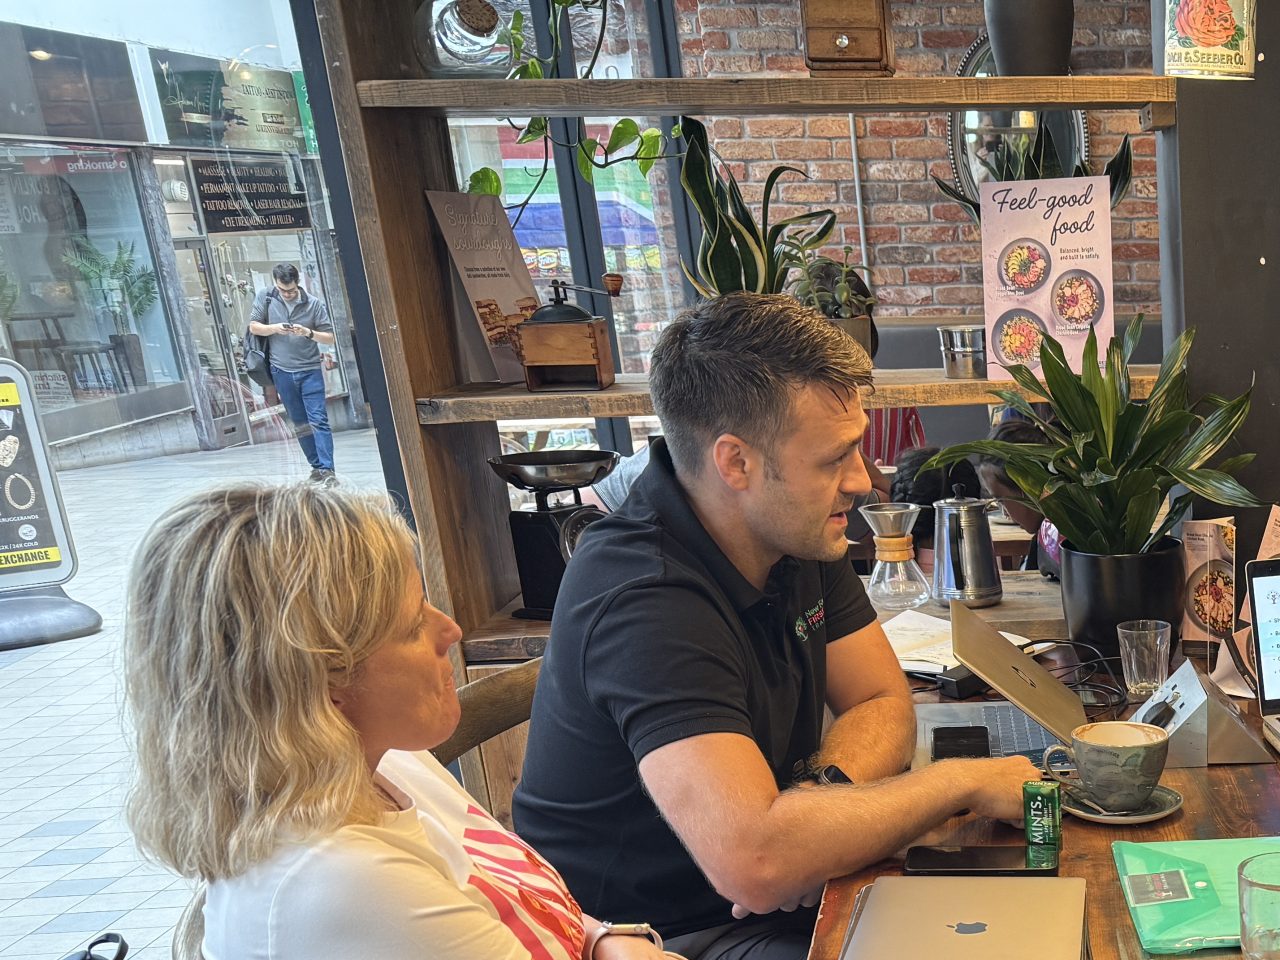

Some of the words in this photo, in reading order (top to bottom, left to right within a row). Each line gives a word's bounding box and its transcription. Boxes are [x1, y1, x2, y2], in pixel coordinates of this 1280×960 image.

[444, 203, 498, 235] Signature
[992, 183, 1094, 220] Feel-good
[1050, 210, 1095, 246] food
[1030, 796, 1044, 844] MINTS.
